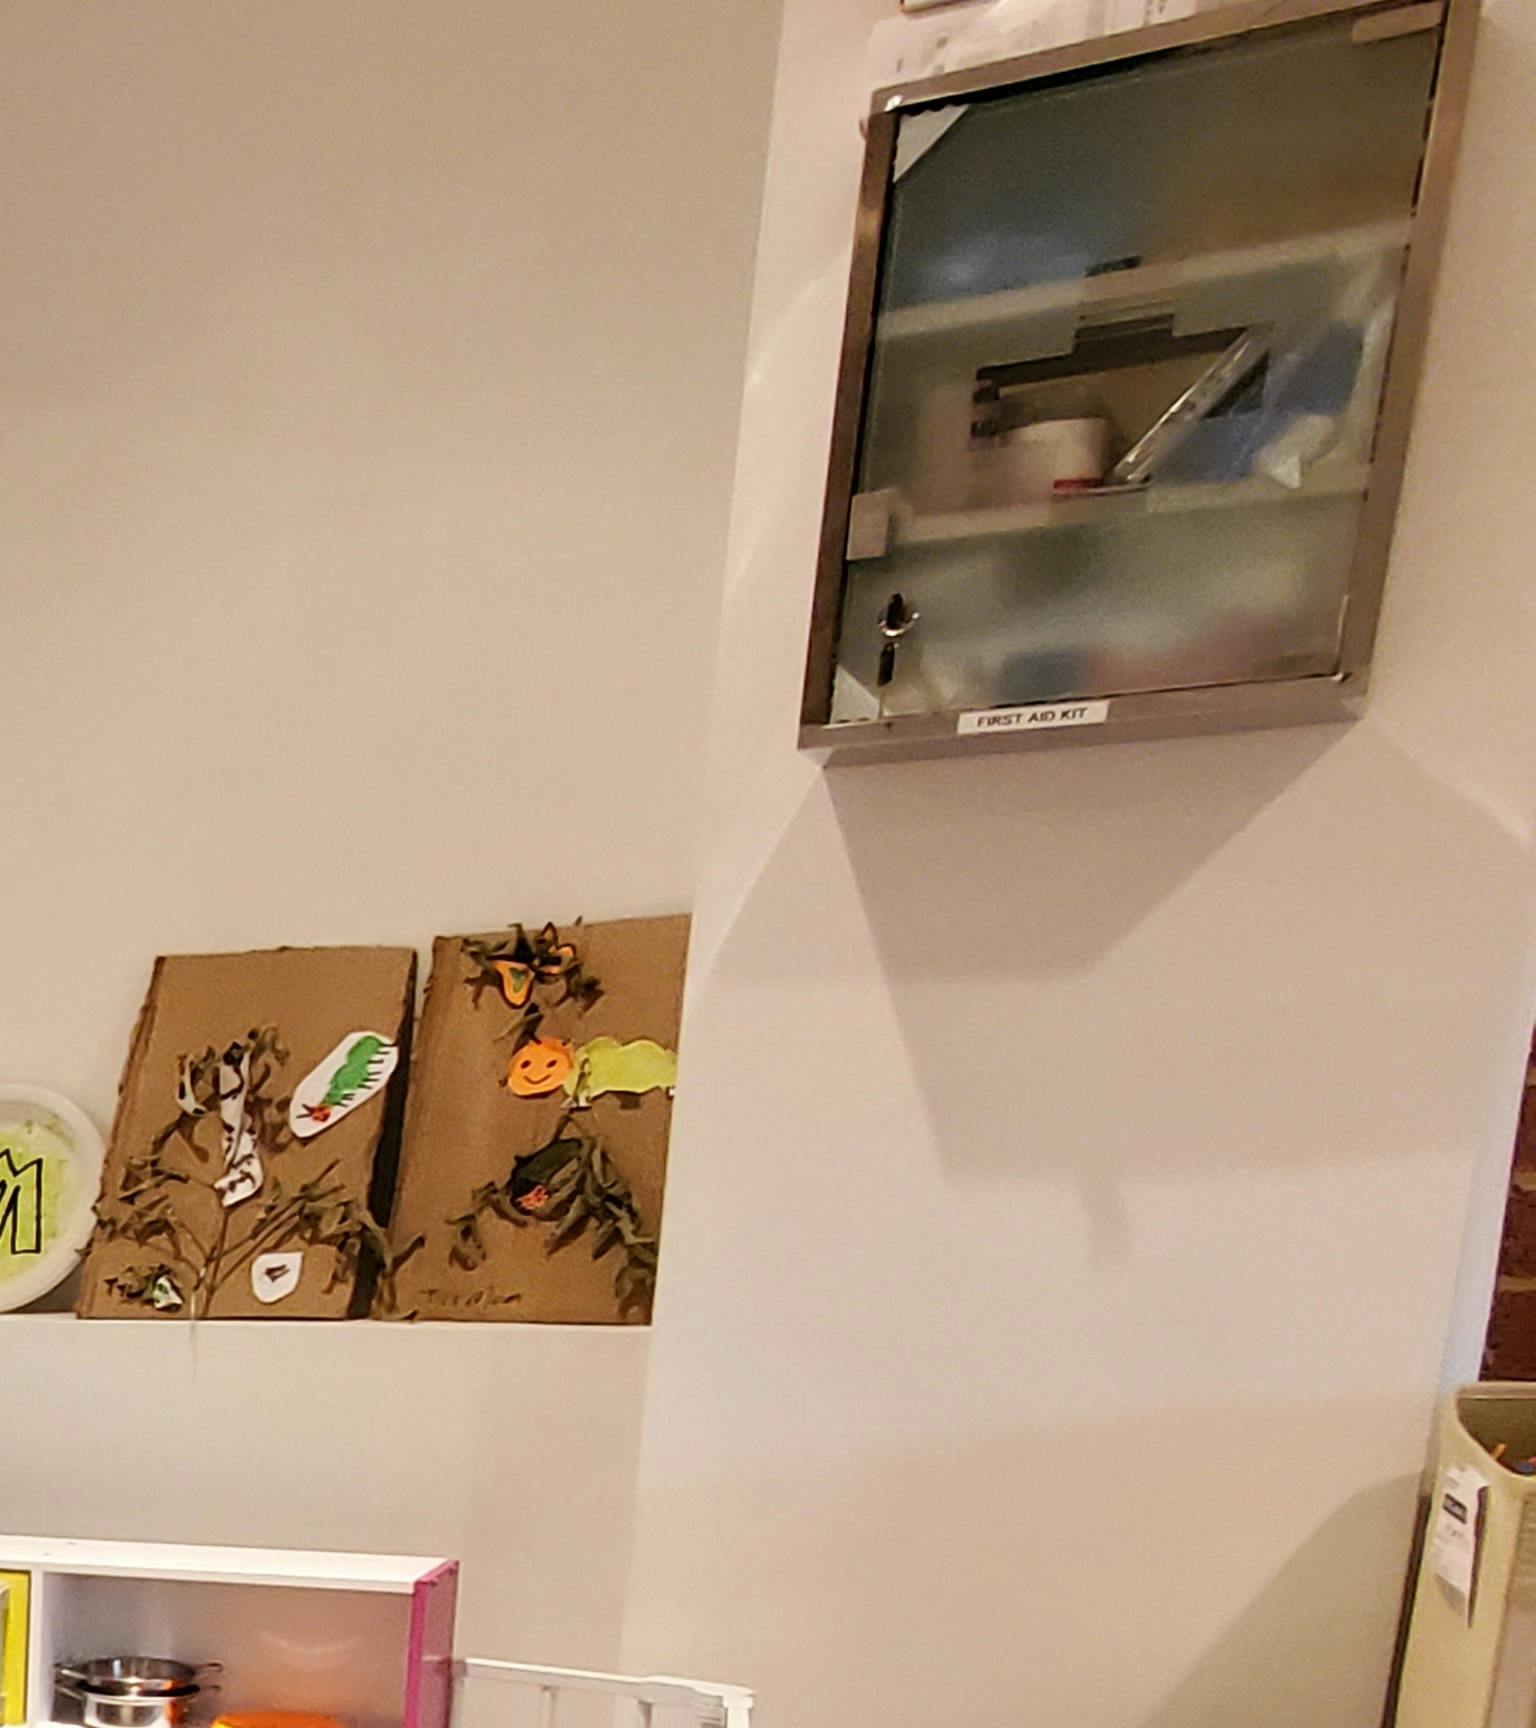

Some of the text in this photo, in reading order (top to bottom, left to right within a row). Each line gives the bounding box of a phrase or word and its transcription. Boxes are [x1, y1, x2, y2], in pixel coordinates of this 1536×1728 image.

[976, 707, 1088, 727] FIRST AID KIT
